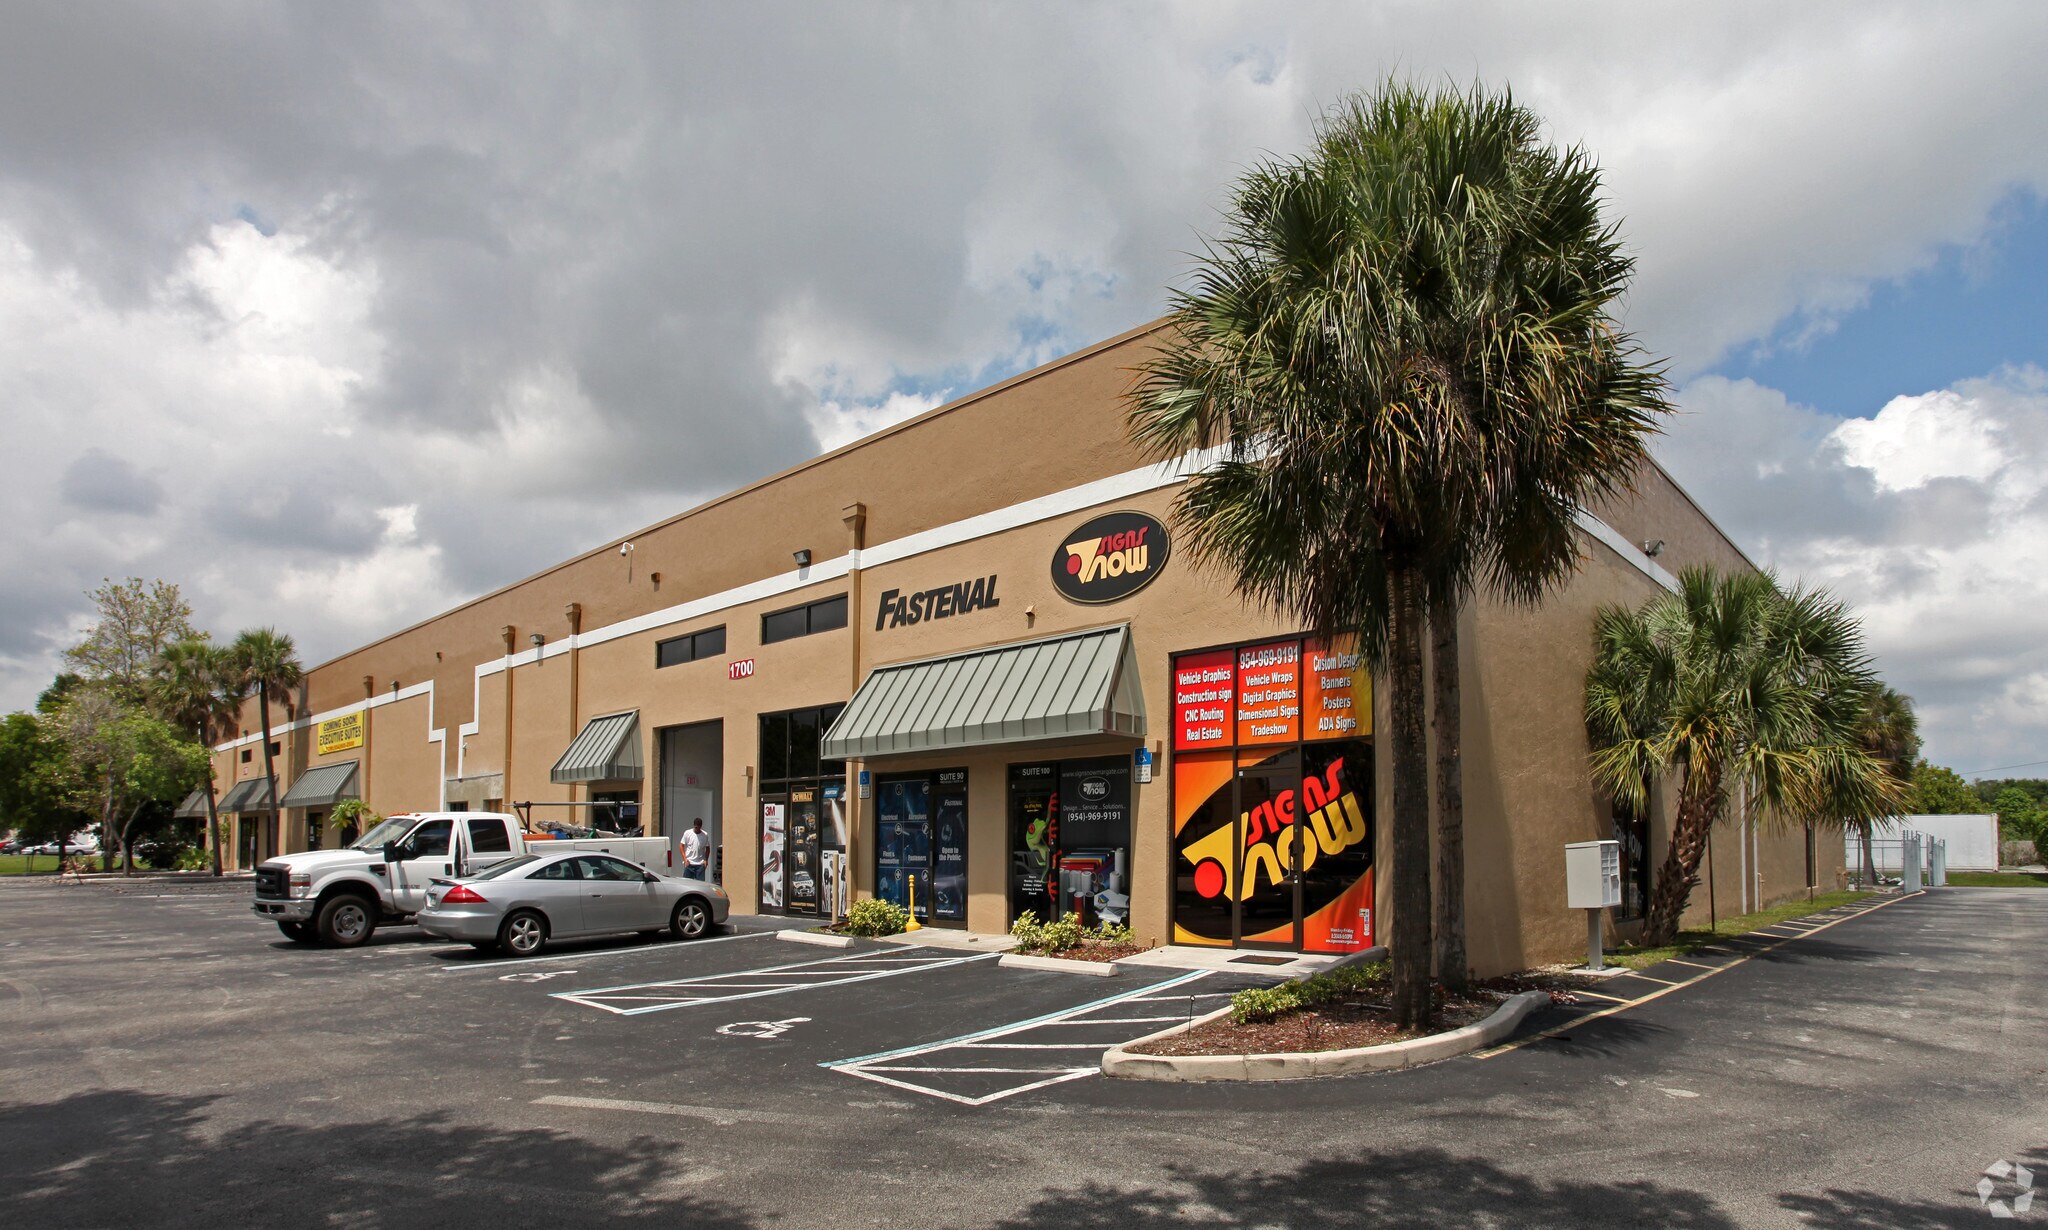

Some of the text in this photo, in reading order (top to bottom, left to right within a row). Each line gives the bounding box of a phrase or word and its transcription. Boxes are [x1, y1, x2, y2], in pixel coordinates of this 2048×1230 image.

[875, 574, 1000, 631] FASTENAL
[1239, 645, 1299, 670] 954-969-9191
[1313, 654, 1337, 672] Custom
[729, 660, 753, 678] 1700
[1178, 669, 1231, 686] Vehicle Graphics
[1245, 672, 1293, 687] Vehicle Wraps
[1321, 676, 1351, 690] Banners
[1177, 688, 1232, 705] Construction sign
[1242, 688, 1296, 705] Digital Graphics
[1323, 696, 1351, 710] Posters
[1185, 708, 1224, 722] CNC Routing
[1238, 705, 1299, 721] Dimensional Signs
[323, 719, 342, 732] COMING
[1251, 723, 1288, 737] Tradeshow
[1318, 716, 1356, 732] ADA Signs
[319, 730, 344, 746] EXECUTIVE
[344, 726, 361, 740] SUITES
[1186, 727, 1222, 741] Real Estate
[940, 772, 964, 781] SUITE 90
[1022, 767, 1050, 776] SUITE 100
[765, 806, 776, 817] 3M
[1068, 811, 1121, 822] (954)-969-9191
[907, 854, 927, 862] Fasteners
[942, 847, 954, 855] Open
